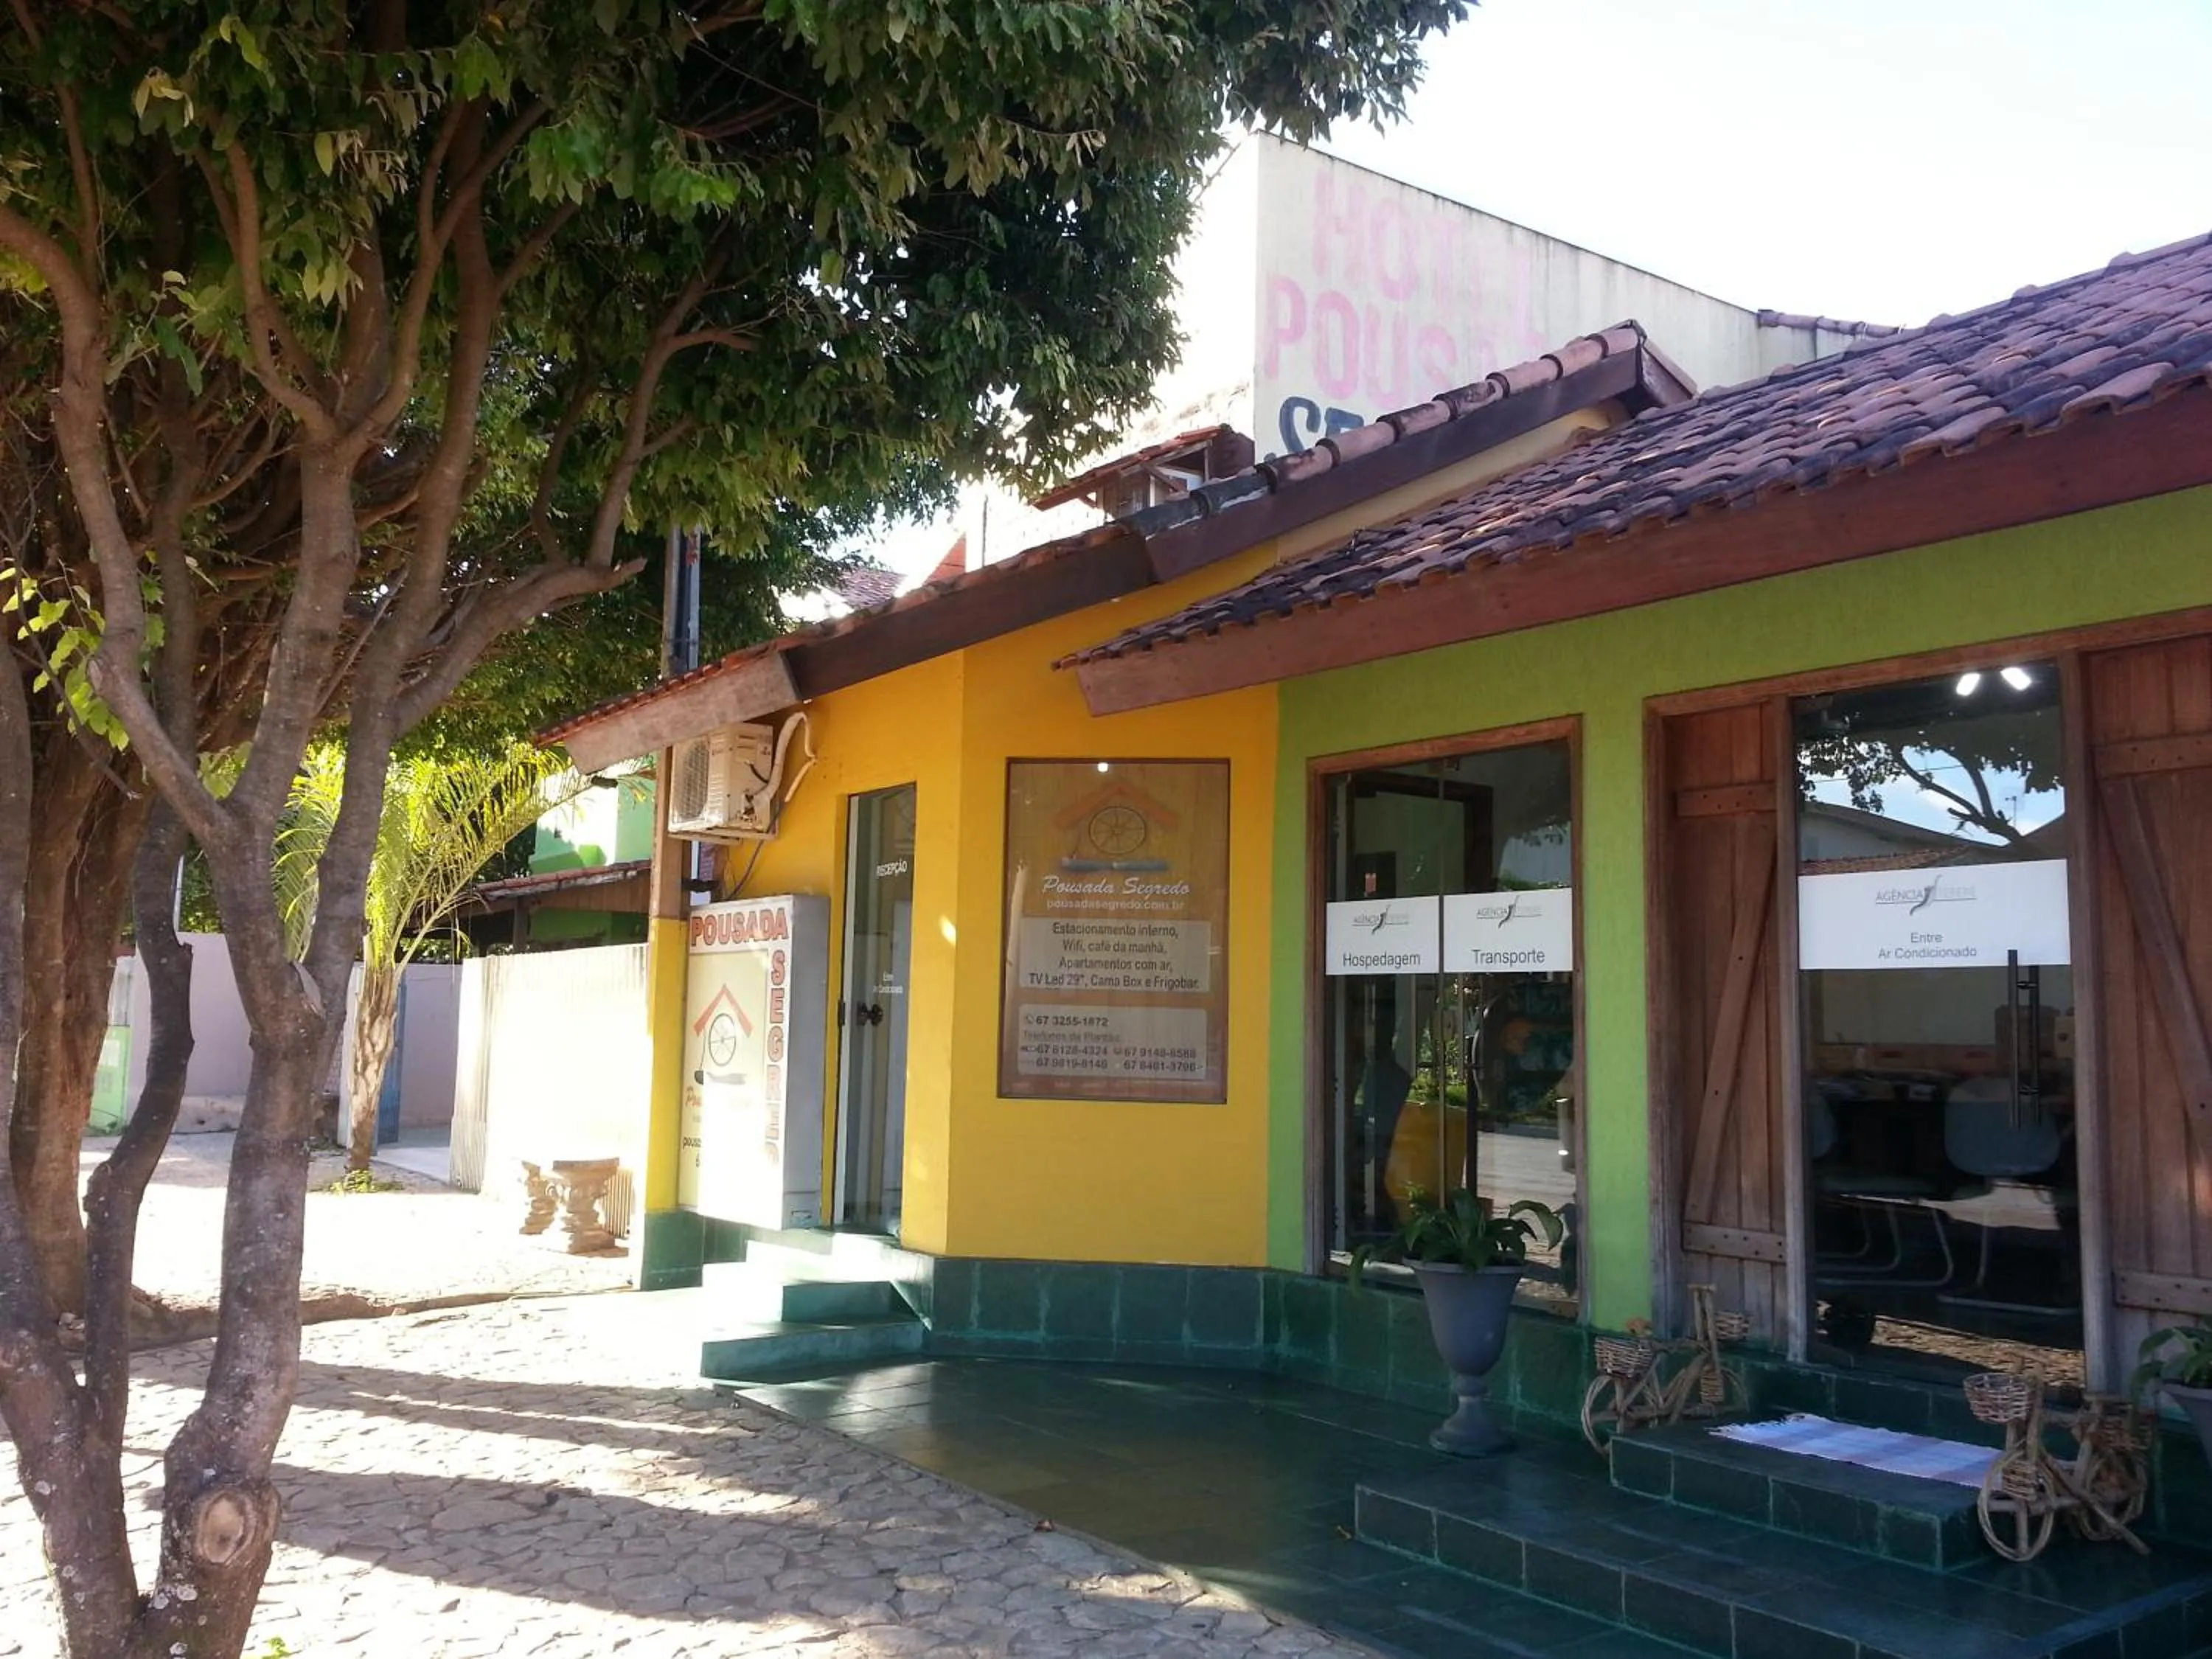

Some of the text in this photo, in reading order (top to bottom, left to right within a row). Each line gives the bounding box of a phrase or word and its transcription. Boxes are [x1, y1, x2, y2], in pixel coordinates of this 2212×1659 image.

[1041, 875, 1190, 900] Pousada Segredo
[690, 907, 790, 947] POUSADA
[1053, 922, 1178, 939] Estacionamento interno,
[1910, 931, 1944, 944] Entre
[1113, 941, 1127, 953] da
[1878, 945, 1978, 959] Ar Condicionado
[1058, 957, 1132, 971] Apartamentos
[1134, 961, 1157, 970] com
[1342, 950, 1422, 971] Hospedagem
[1471, 947, 1545, 967] Transporte
[1029, 973, 1043, 984] TV
[1091, 974, 1121, 987] Cama
[1123, 975, 1142, 987] Box
[1145, 978, 1151, 987] e
[1036, 1016, 1048, 1026] 67
[765, 949, 786, 1165] SEGRE
